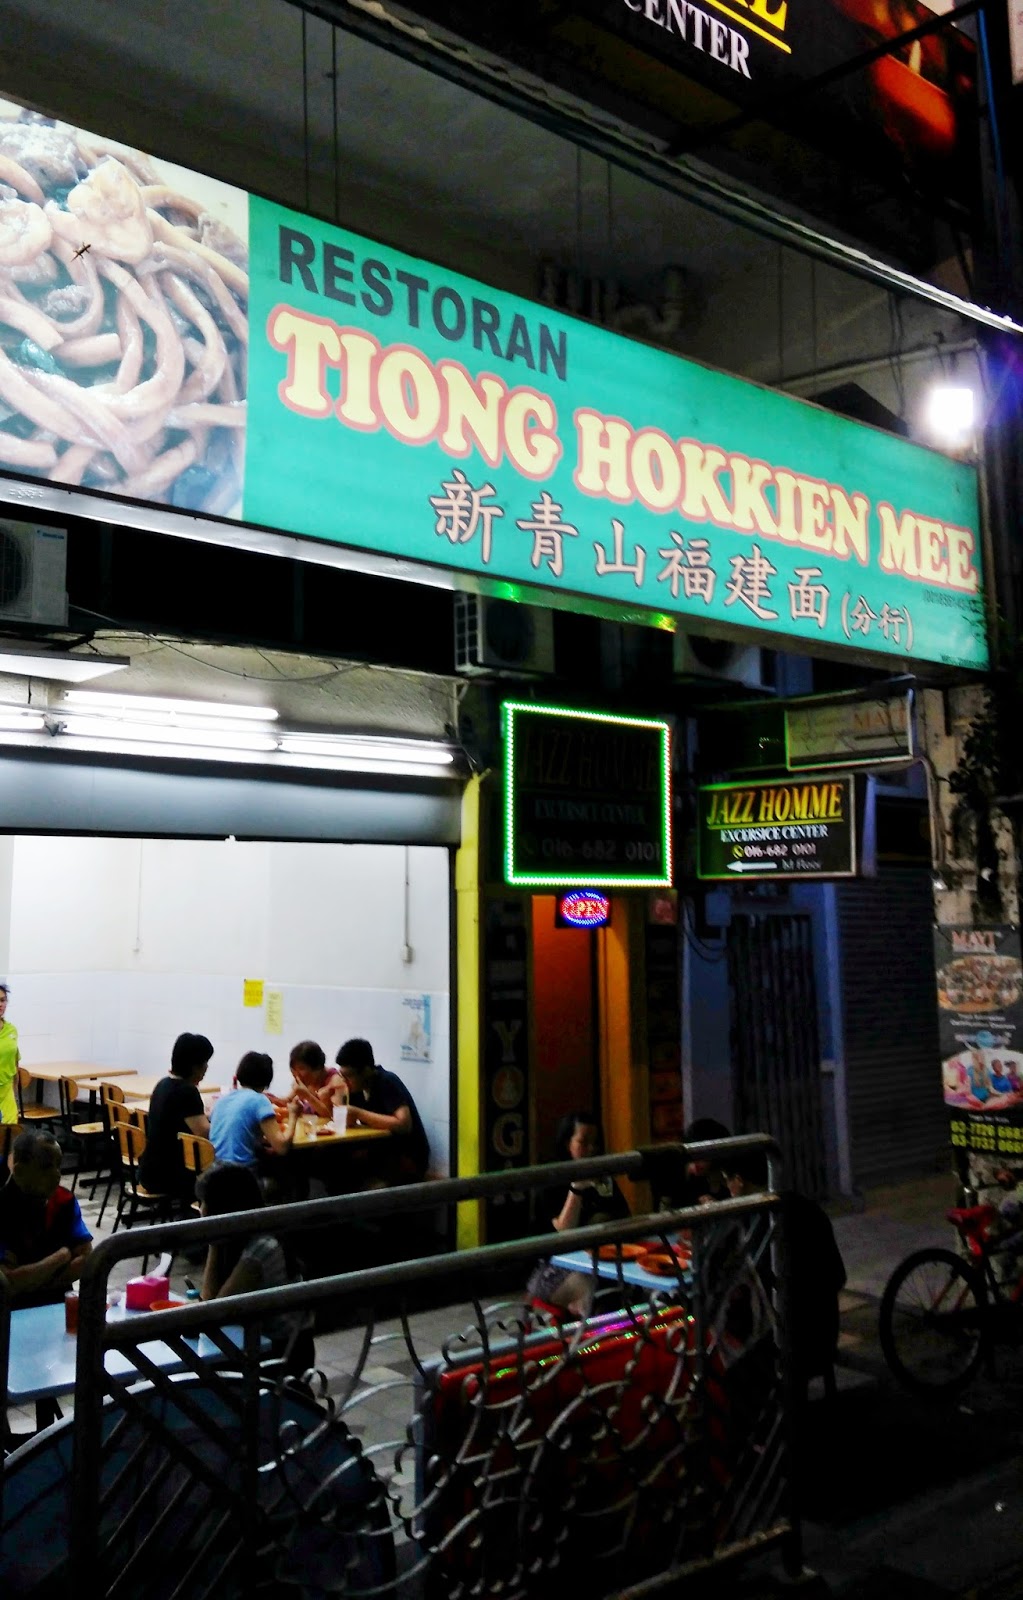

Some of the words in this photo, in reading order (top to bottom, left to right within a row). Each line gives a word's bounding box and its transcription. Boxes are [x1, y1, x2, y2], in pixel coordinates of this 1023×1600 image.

[278, 224, 567, 382] RESTORAN
[266, 303, 563, 482] TIONG
[573, 407, 870, 567] HOKKIEN
[877, 502, 980, 594] MEE
[706, 790, 756, 825] JAZZ
[759, 783, 843, 821] HOMME
[781, 824, 829, 840] CENTER
[744, 844, 788, 858] 016-682
[792, 843, 816, 856] 0101
[561, 899, 608, 919] OPEN
